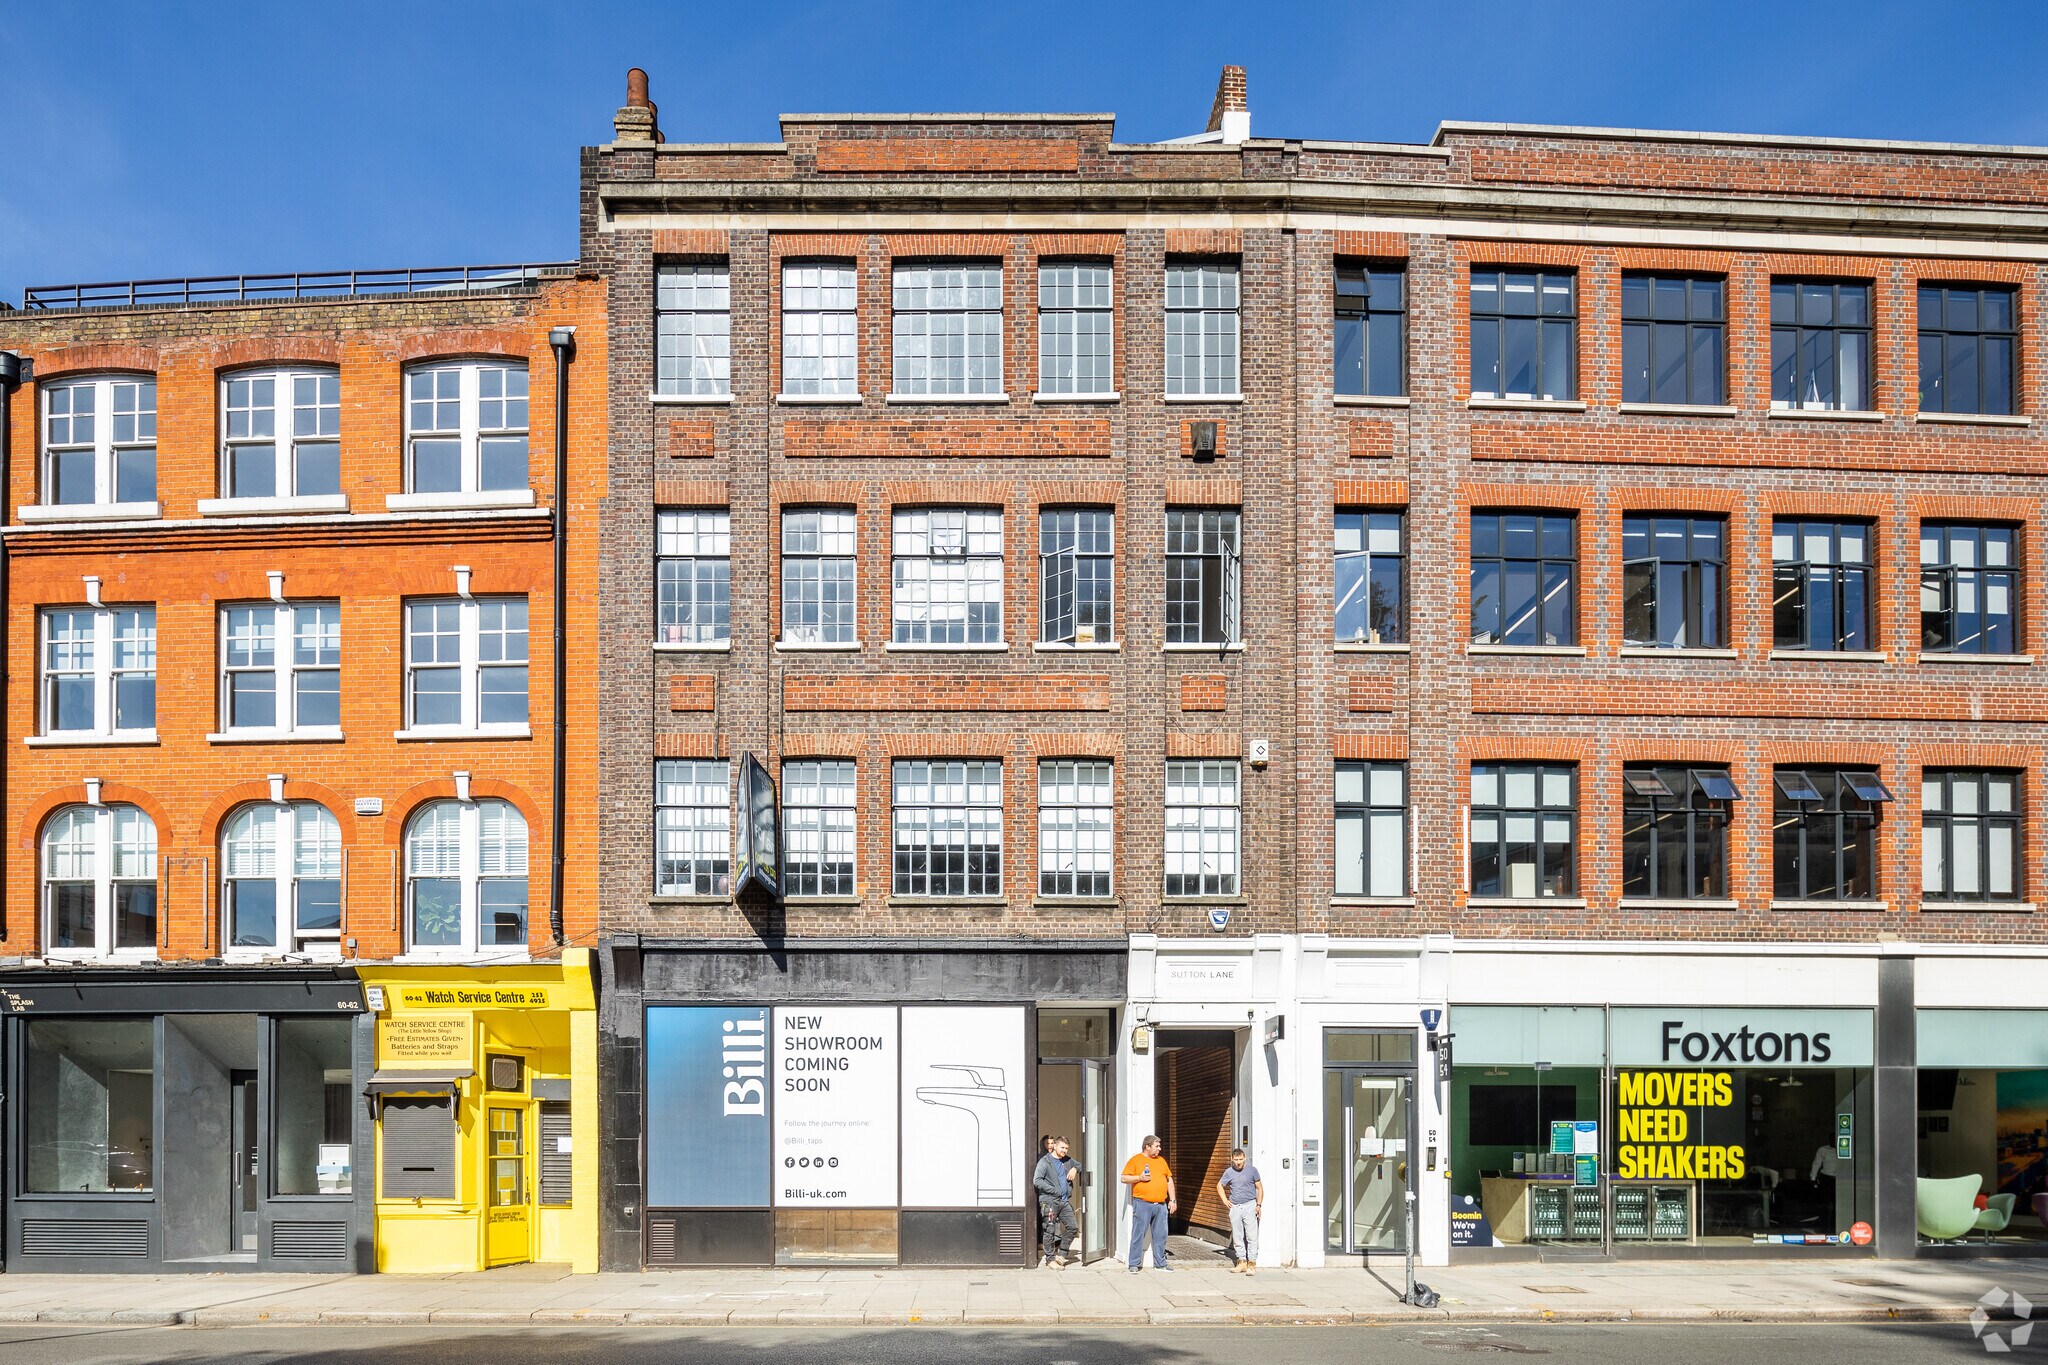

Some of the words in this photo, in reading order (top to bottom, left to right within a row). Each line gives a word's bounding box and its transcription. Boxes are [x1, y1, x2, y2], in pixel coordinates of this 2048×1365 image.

[1171, 971, 1206, 979] SUTTON
[1210, 971, 1234, 979] LANE
[425, 991, 454, 1003] Watch
[458, 991, 492, 1003] Service
[495, 991, 525, 1003] Centre
[784, 1016, 822, 1030] NEW
[784, 1036, 883, 1050] SHOWROOM
[1662, 1021, 1831, 1062] Foxtons
[1439, 1047, 1448, 1061] 50
[722, 1018, 765, 1117] Billi
[784, 1057, 849, 1071] COMING
[1439, 1063, 1448, 1077] 54
[784, 1078, 830, 1092] SOON
[1619, 1072, 1733, 1107] MOVERS
[784, 1119, 807, 1127] Follow
[808, 1119, 820, 1127] the
[821, 1120, 847, 1128] journey
[1619, 1109, 1688, 1143] NEED
[784, 1137, 823, 1145] @Billi_taps
[1619, 1145, 1745, 1180] SHAKERS
[785, 1189, 847, 1198] Billi-uk.com
[1452, 1211, 1482, 1220] Boomin
[1452, 1221, 1476, 1230] We're
[1464, 1230, 1473, 1238] it.
